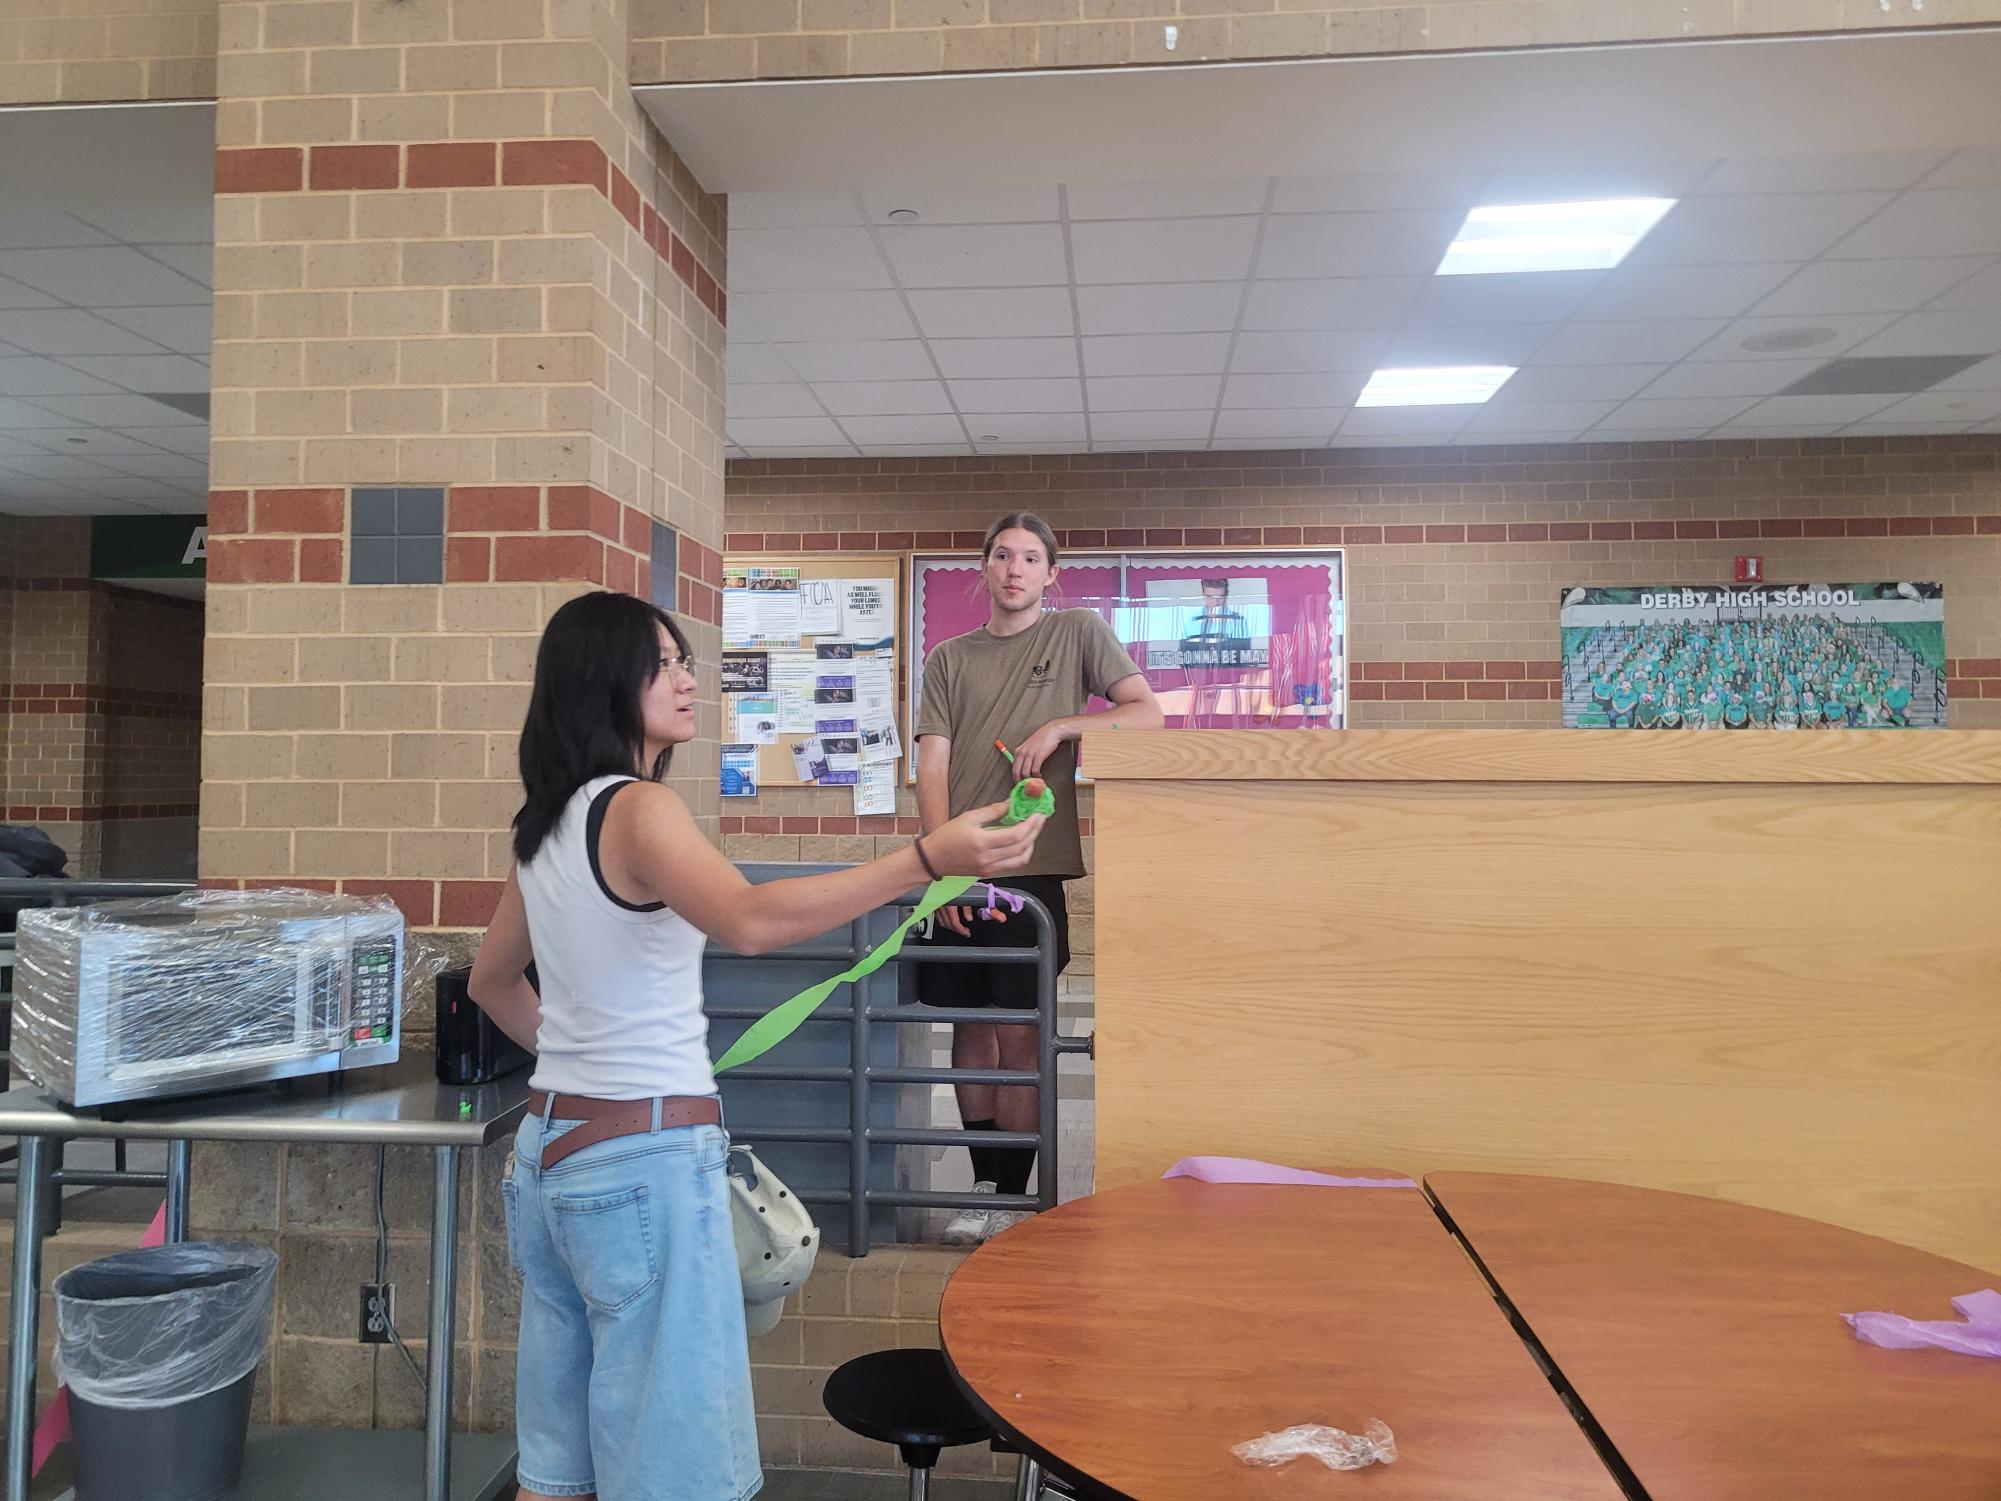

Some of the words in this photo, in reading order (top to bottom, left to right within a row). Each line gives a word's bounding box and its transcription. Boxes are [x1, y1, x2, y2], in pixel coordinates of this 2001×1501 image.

[1641, 593, 1708, 609] DERBY
[1715, 591, 1768, 607] HIGH
[1773, 590, 1861, 607] SCHOOL
[1175, 650, 1218, 664] GONNA
[1221, 650, 1237, 664] BE
[1240, 649, 1268, 663] MAY
